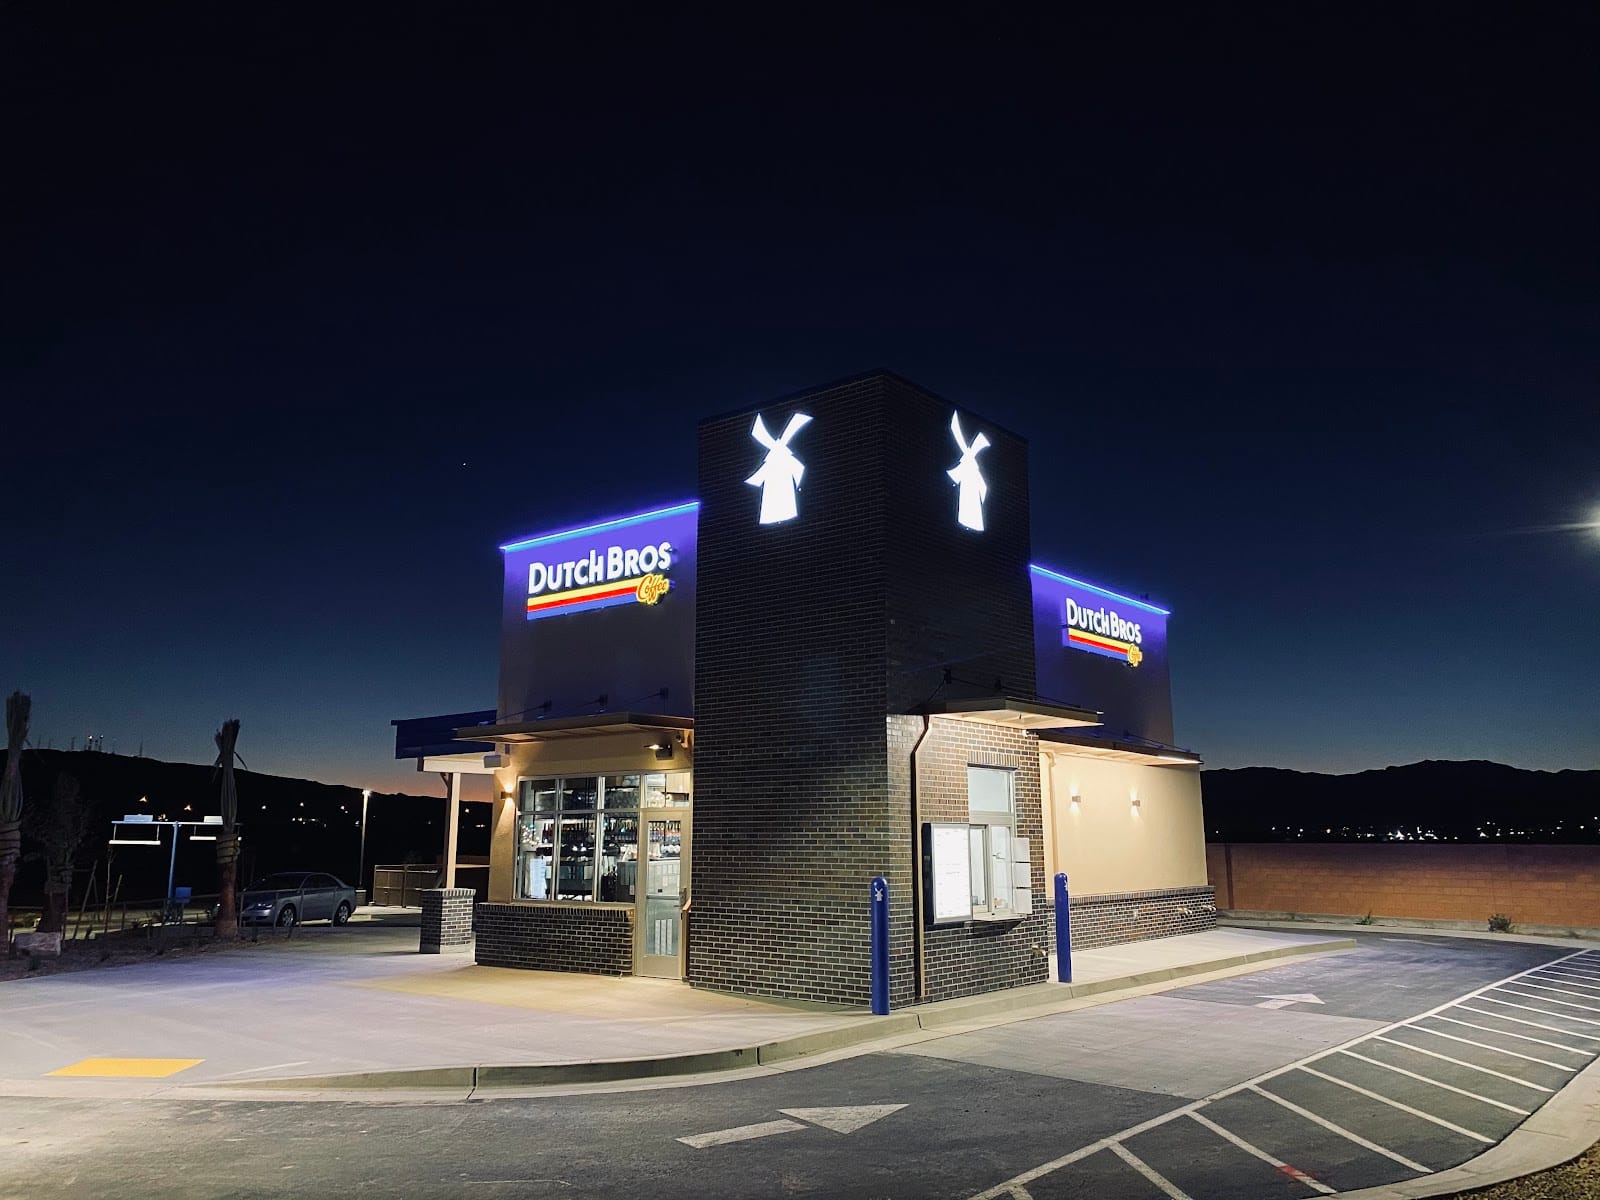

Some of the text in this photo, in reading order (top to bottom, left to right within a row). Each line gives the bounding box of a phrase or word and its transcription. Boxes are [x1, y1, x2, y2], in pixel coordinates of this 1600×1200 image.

[607, 542, 672, 580] BROS
[637, 575, 667, 602] Coffee
[1110, 611, 1142, 644] BROS
